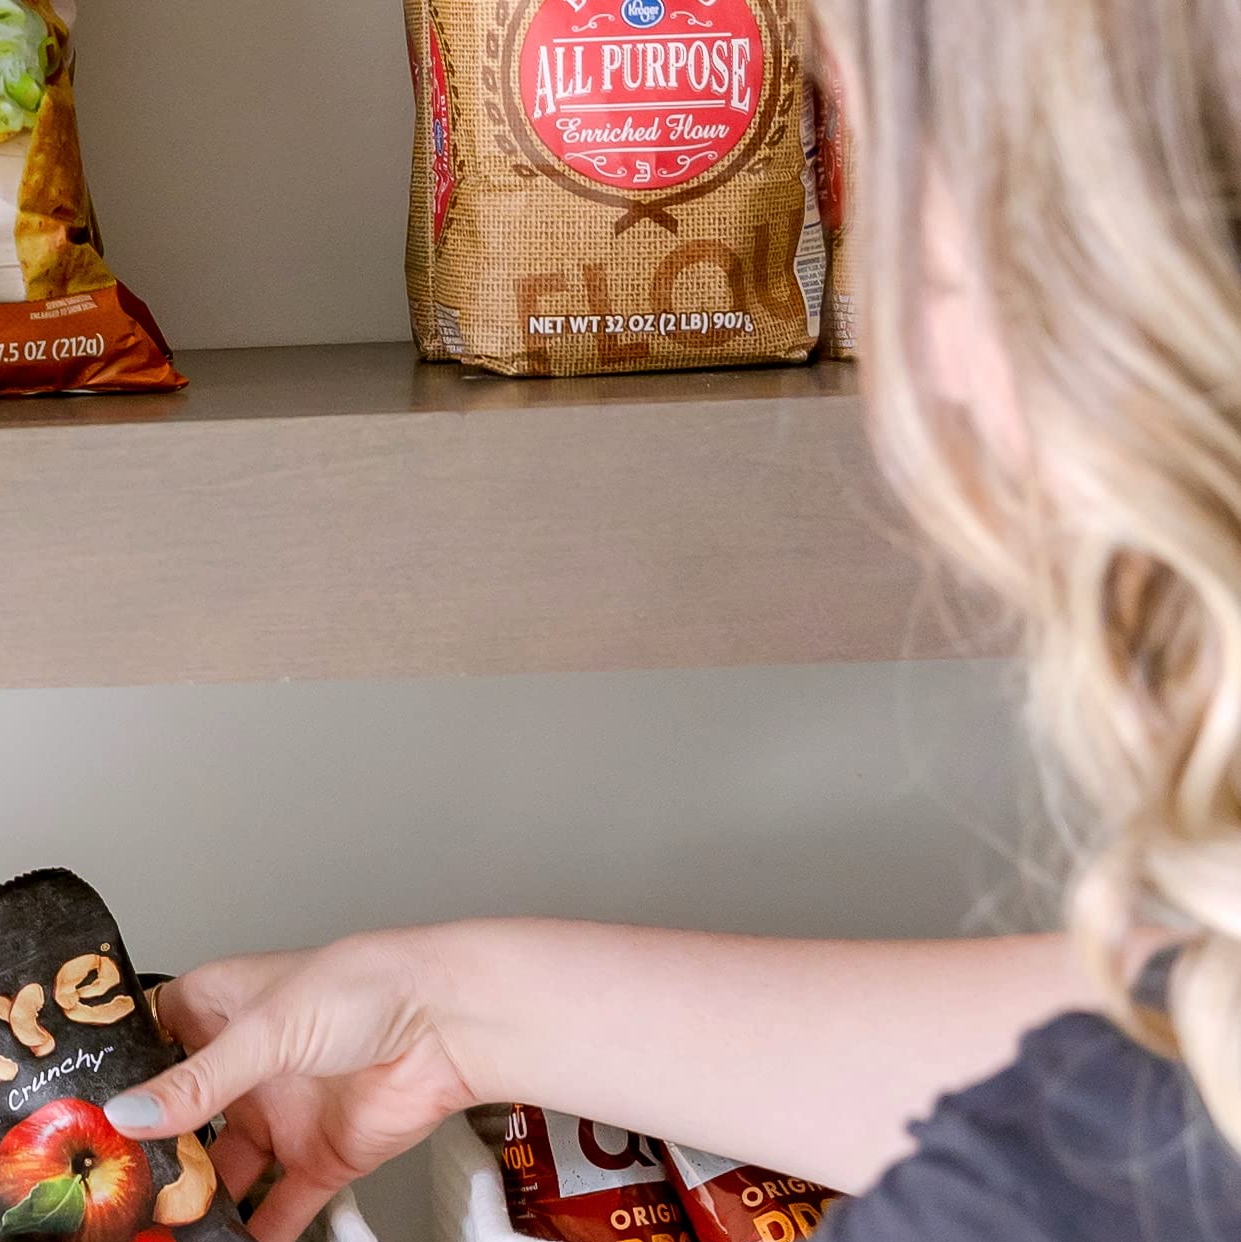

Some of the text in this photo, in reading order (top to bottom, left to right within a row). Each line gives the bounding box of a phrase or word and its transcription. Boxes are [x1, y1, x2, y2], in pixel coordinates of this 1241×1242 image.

[628, 0, 659, 22] Kroger
[533, 38, 751, 119] ALL PURPOSE
[556, 114, 730, 144] Enriched Flour
[529, 311, 754, 335] NET WT 32 OZ (2 LB) 907g
[24, 340, 47, 360] OZ
[52, 333, 105, 361] (212g)
[8, 1048, 105, 1111] Crunchy
[610, 1203, 677, 1231] ORIGI
